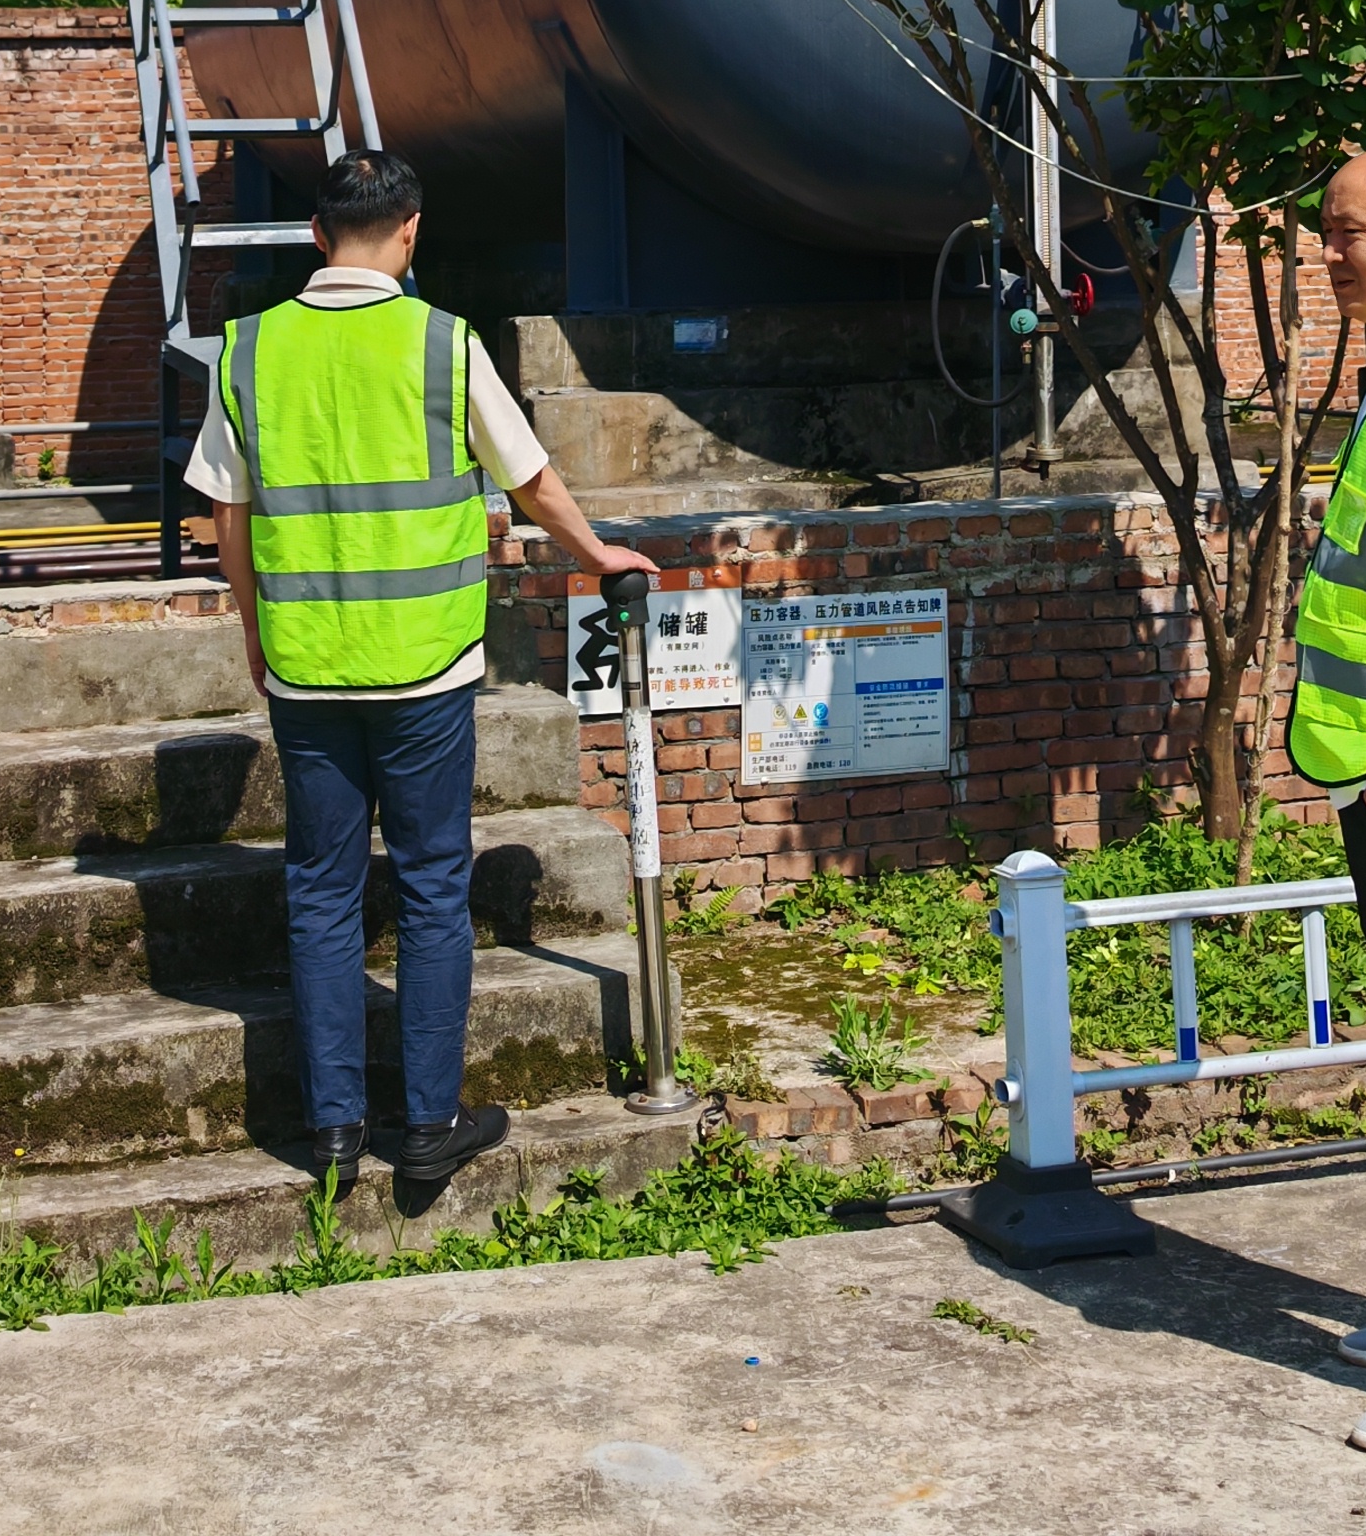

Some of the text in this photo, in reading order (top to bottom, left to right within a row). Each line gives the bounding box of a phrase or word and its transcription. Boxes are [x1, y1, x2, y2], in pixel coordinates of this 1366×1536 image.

[750, 597, 943, 623] 压力容器、压力管道风险点告知牌
[658, 612, 708, 638] 储罐
